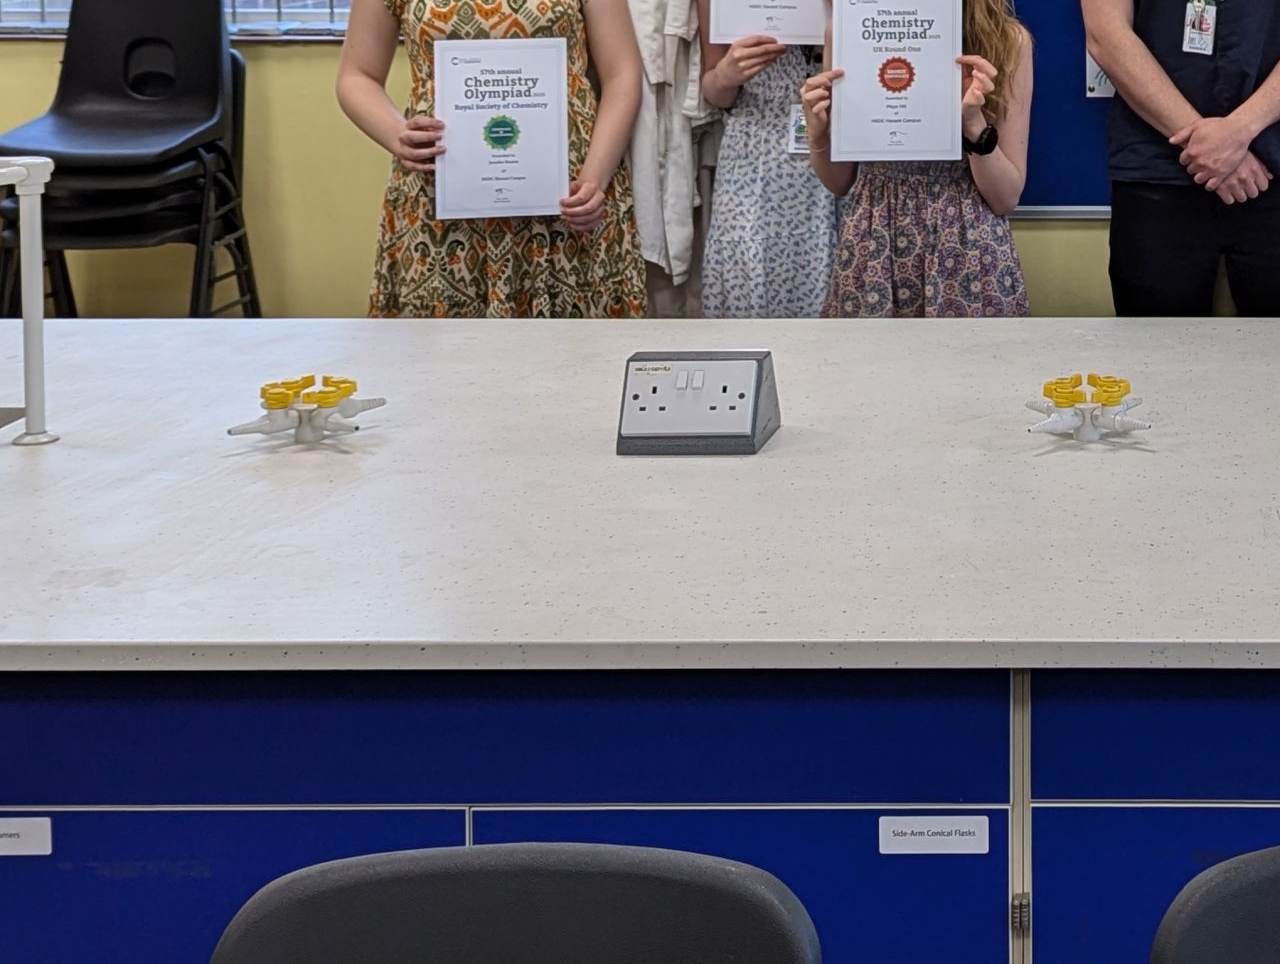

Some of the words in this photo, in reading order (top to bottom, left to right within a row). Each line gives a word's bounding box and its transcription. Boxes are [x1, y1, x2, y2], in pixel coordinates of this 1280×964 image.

[861, 17, 935, 31] Chemistry
[861, 28, 928, 43] Olympiad
[480, 68, 496, 76] 57th
[497, 67, 522, 75] annual
[464, 76, 539, 91] Chemistry
[464, 87, 532, 102] Olympiad
[454, 104, 475, 112] Royal
[476, 103, 501, 111] Society
[512, 102, 549, 110] Chemistry
[891, 829, 926, 838] Side-Arm
[926, 829, 953, 837] Conical
[954, 829, 976, 837] Flasks
